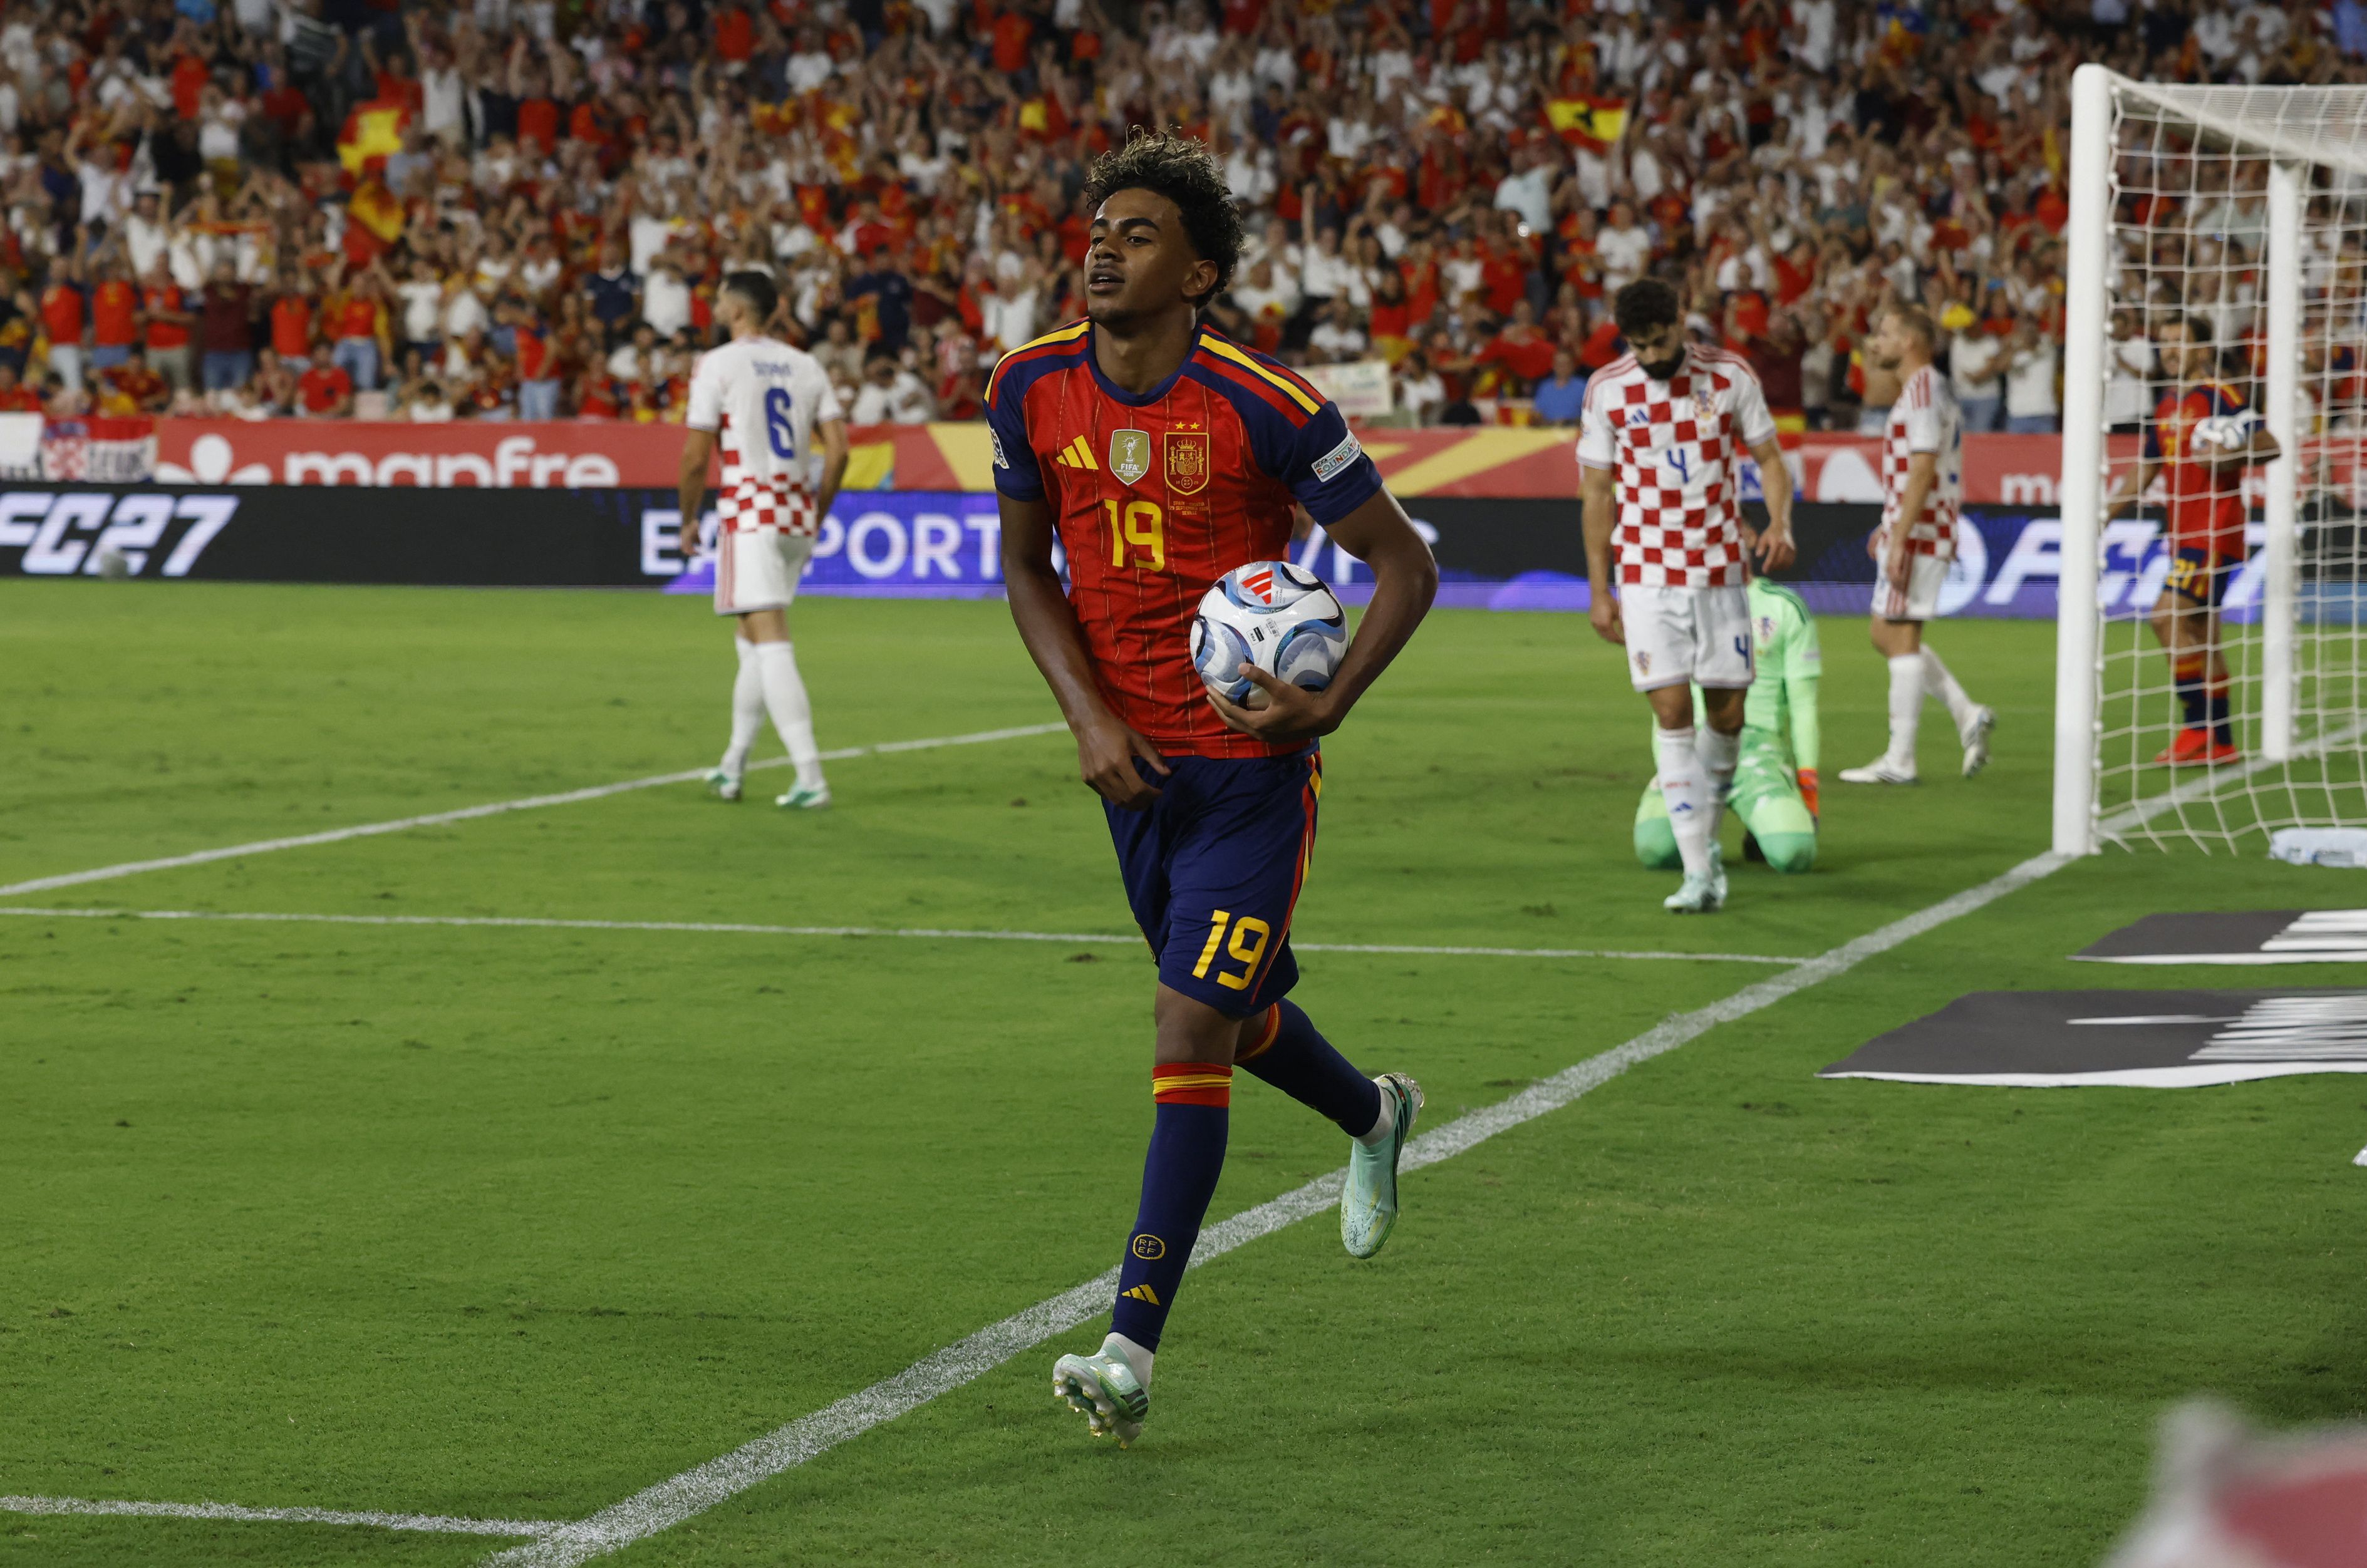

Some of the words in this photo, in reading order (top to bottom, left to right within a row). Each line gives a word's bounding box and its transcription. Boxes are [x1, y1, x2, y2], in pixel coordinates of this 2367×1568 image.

[765, 386, 794, 460] 6
[1313, 458, 1328, 469] UEFA
[1316, 442, 1356, 475] FOUNDAT
[1667, 448, 1689, 484] 4
[803, 510, 1072, 580] PORT
[1104, 498, 1165, 572] 19
[1734, 633, 1750, 671] 4
[1192, 909, 1270, 991] 19
